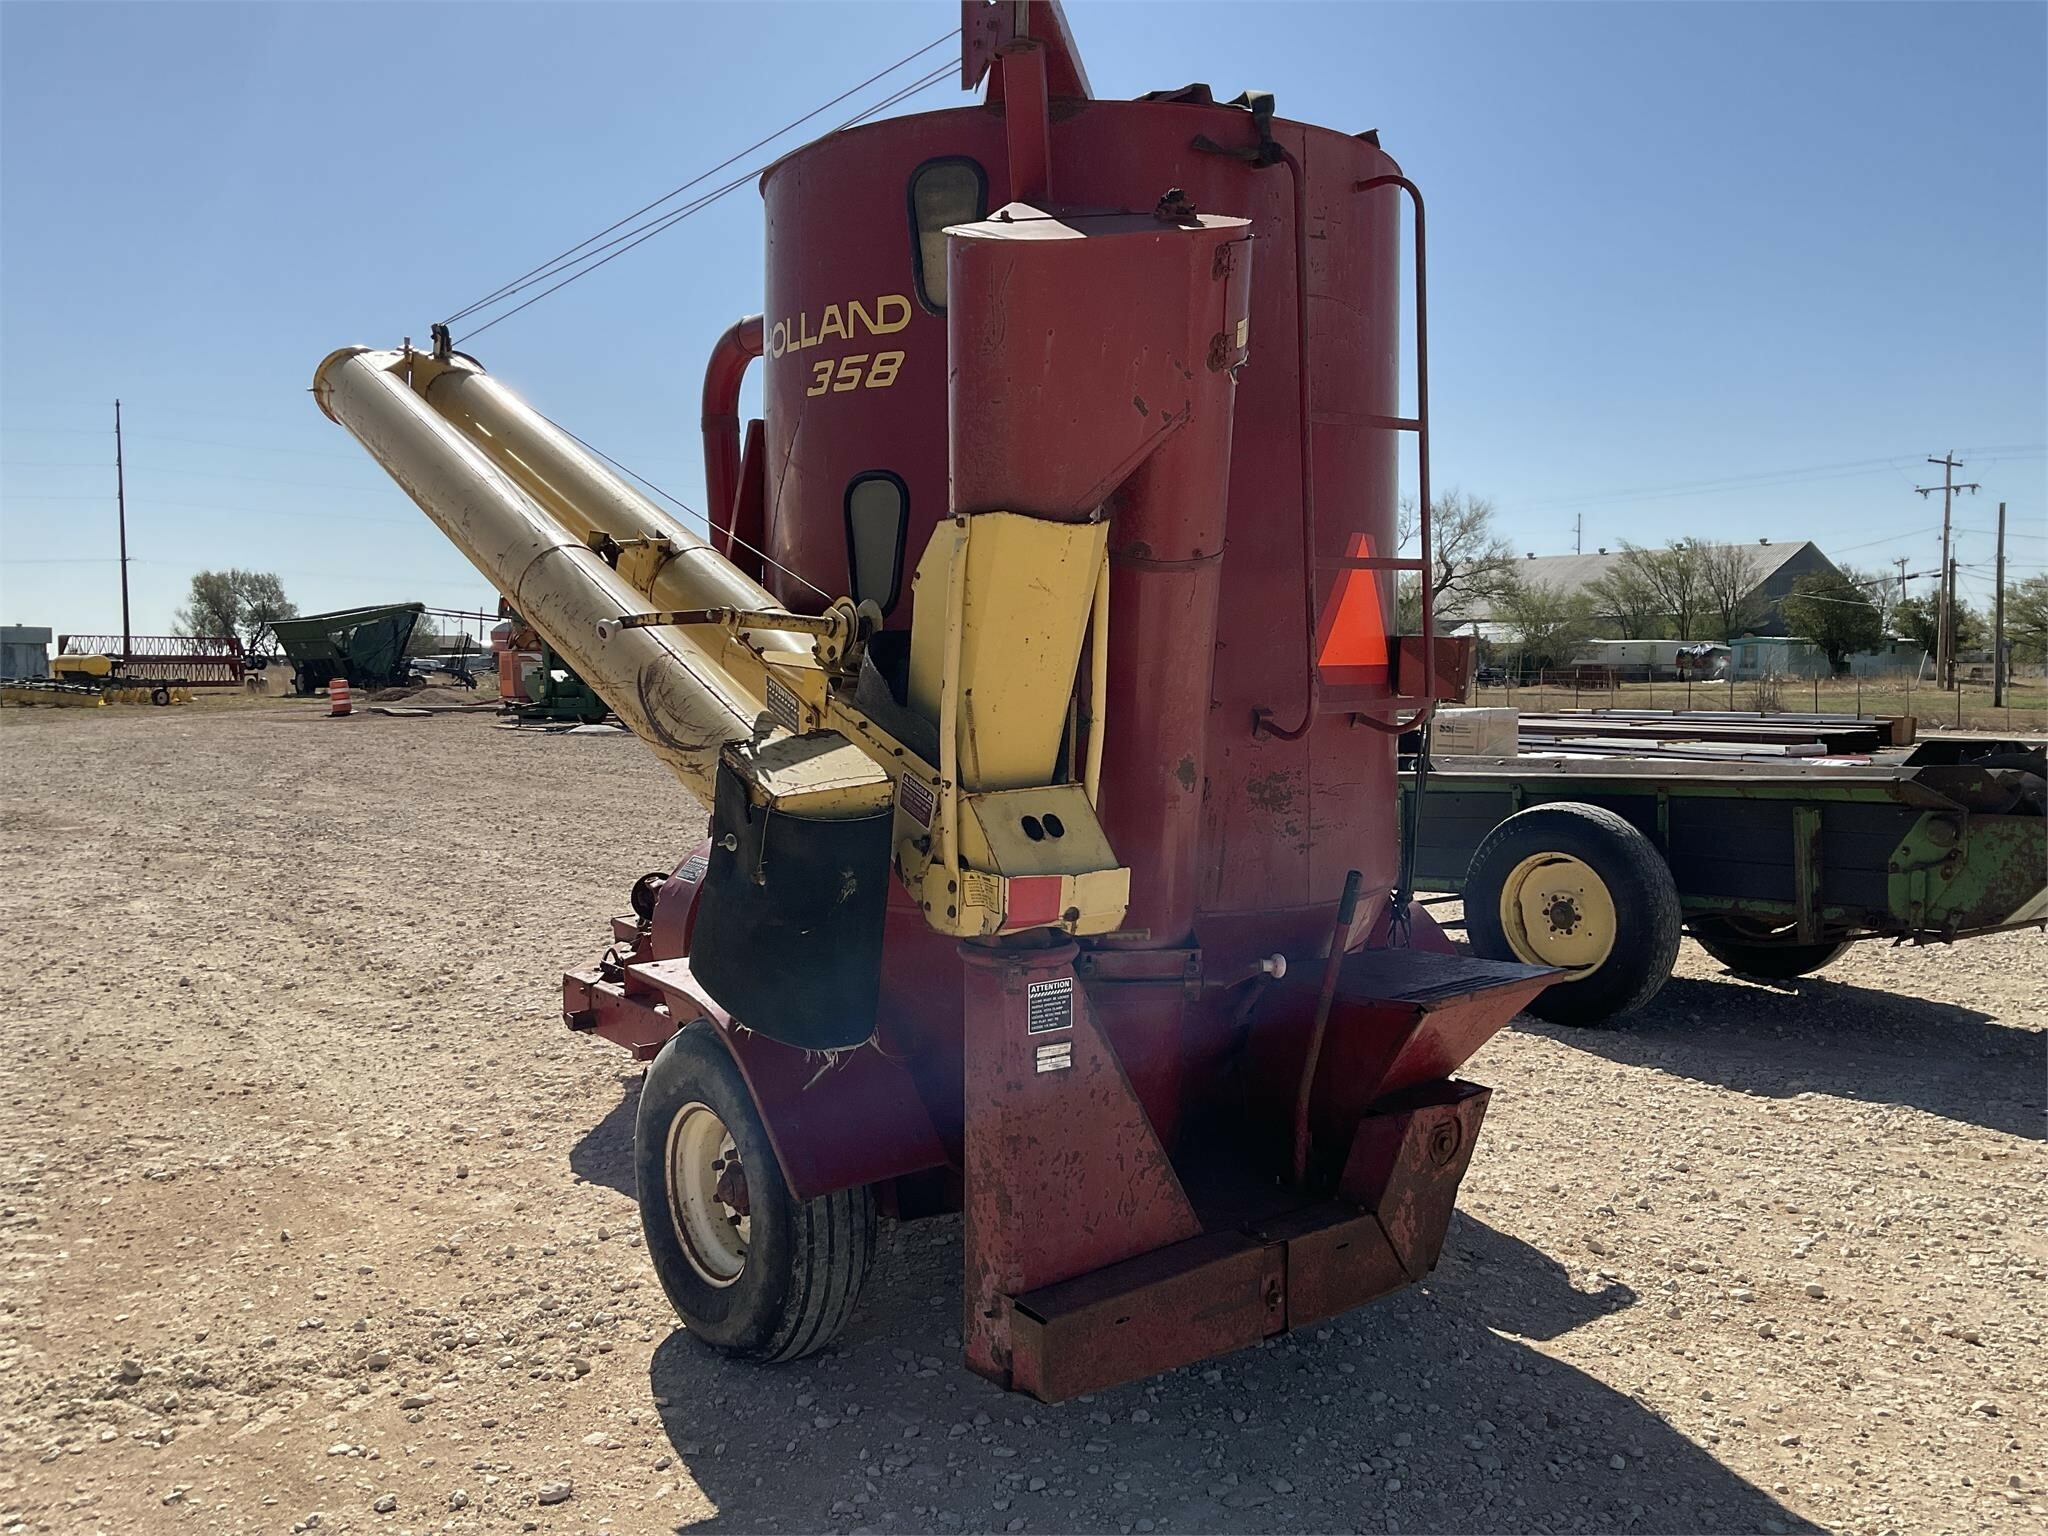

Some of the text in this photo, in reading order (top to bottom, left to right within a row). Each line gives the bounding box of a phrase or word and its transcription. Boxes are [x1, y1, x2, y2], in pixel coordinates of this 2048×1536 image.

[807, 351, 905, 397] 358
[769, 680, 797, 707] ATTENTION
[1031, 981, 1070, 993] ATTENTION
